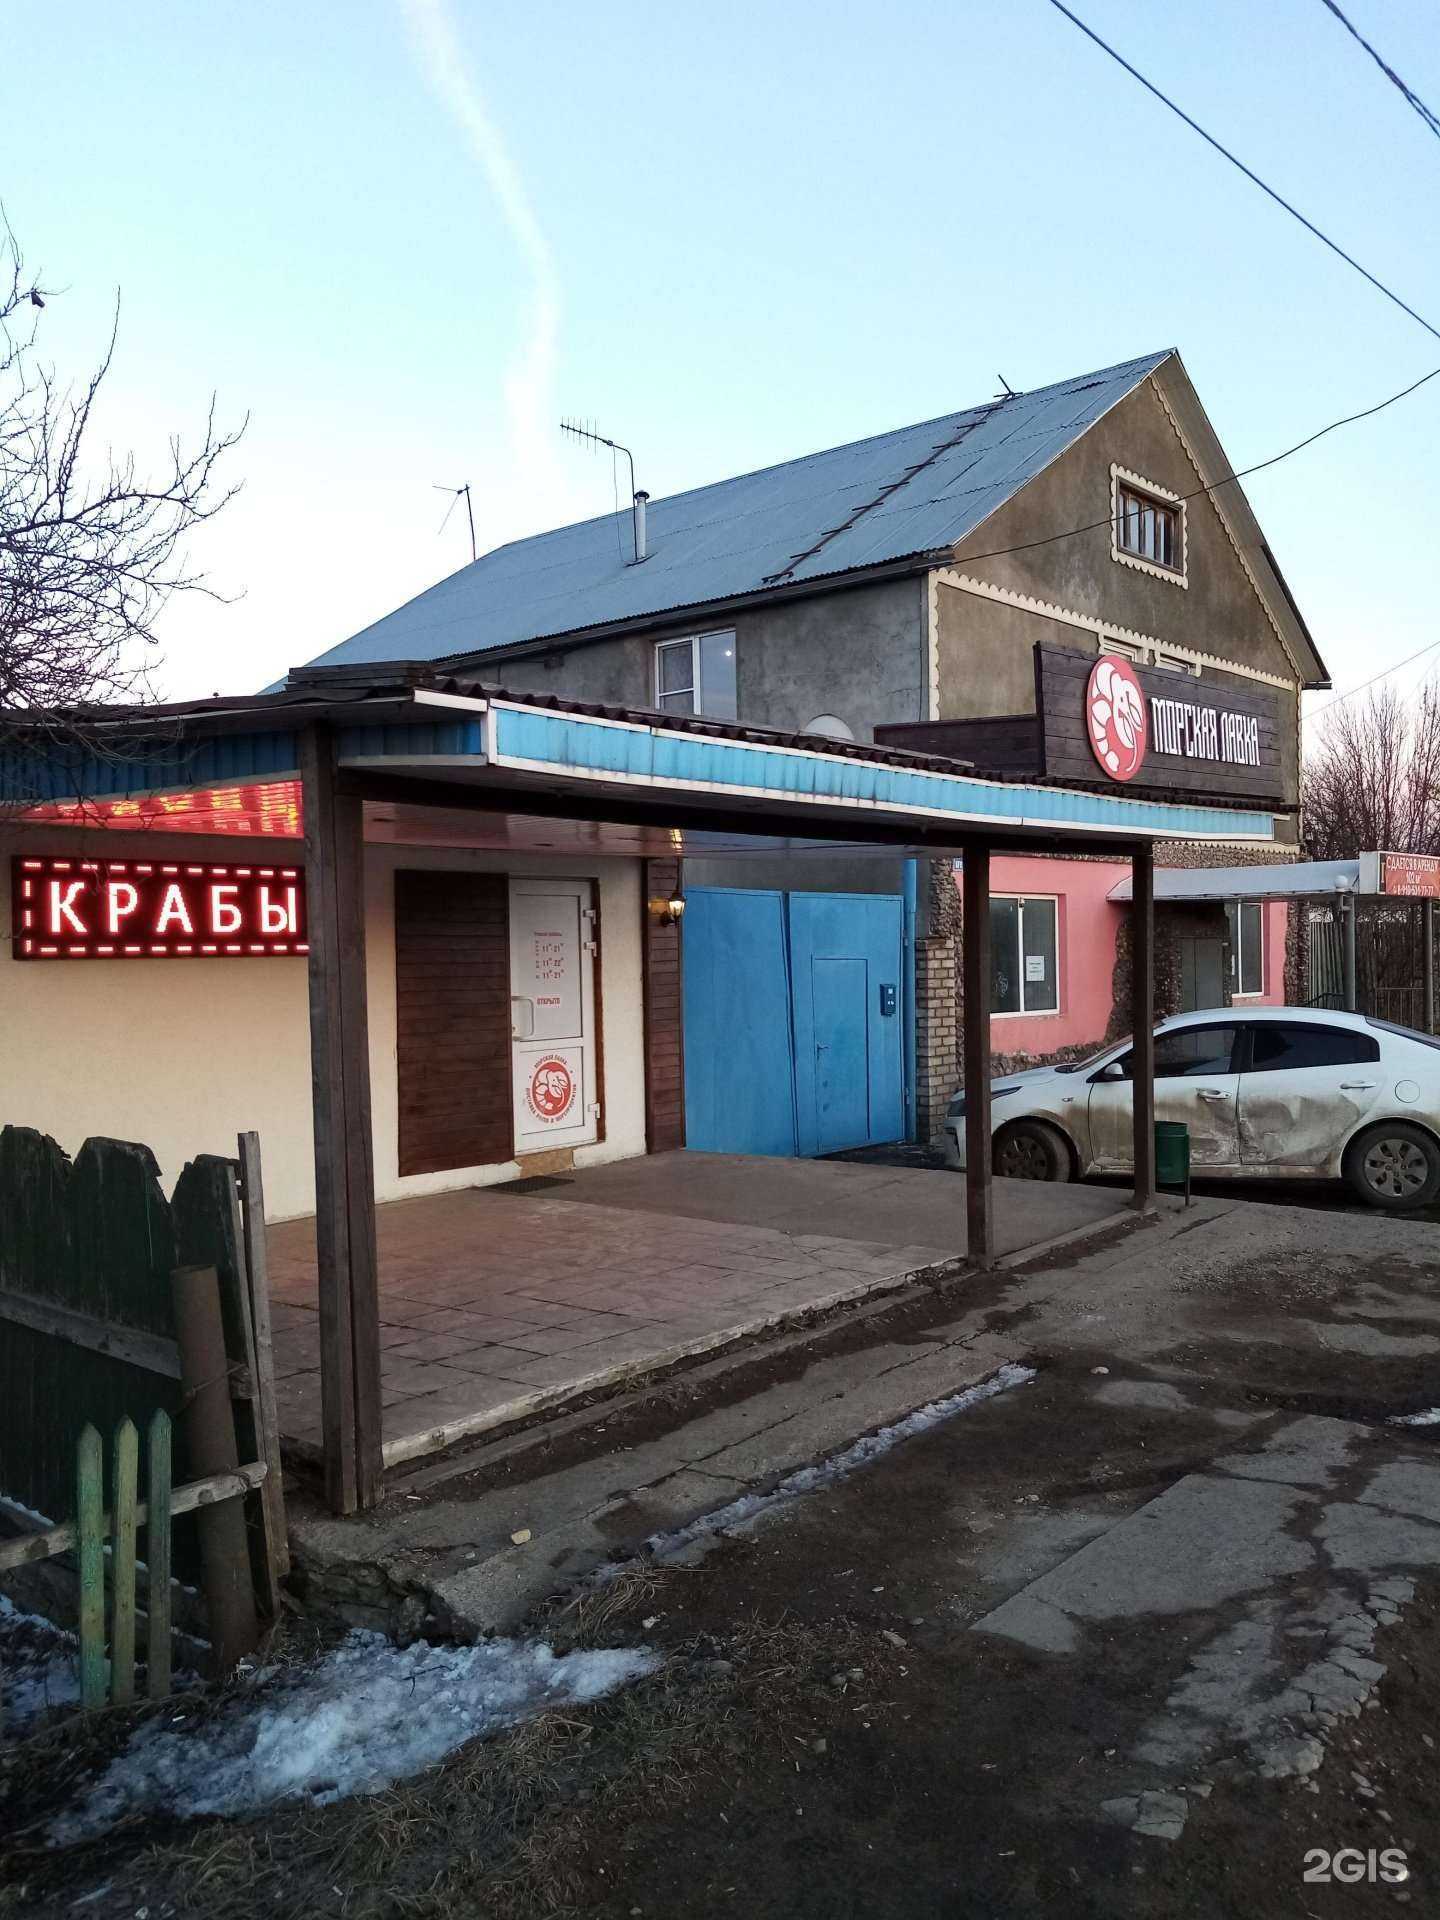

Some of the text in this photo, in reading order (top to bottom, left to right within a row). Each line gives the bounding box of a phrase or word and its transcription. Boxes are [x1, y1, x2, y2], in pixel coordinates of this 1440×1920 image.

[1151, 697, 1261, 766] МОРСКАЯ ЛАВКА
[50, 880, 297, 933] КРАБЫ
